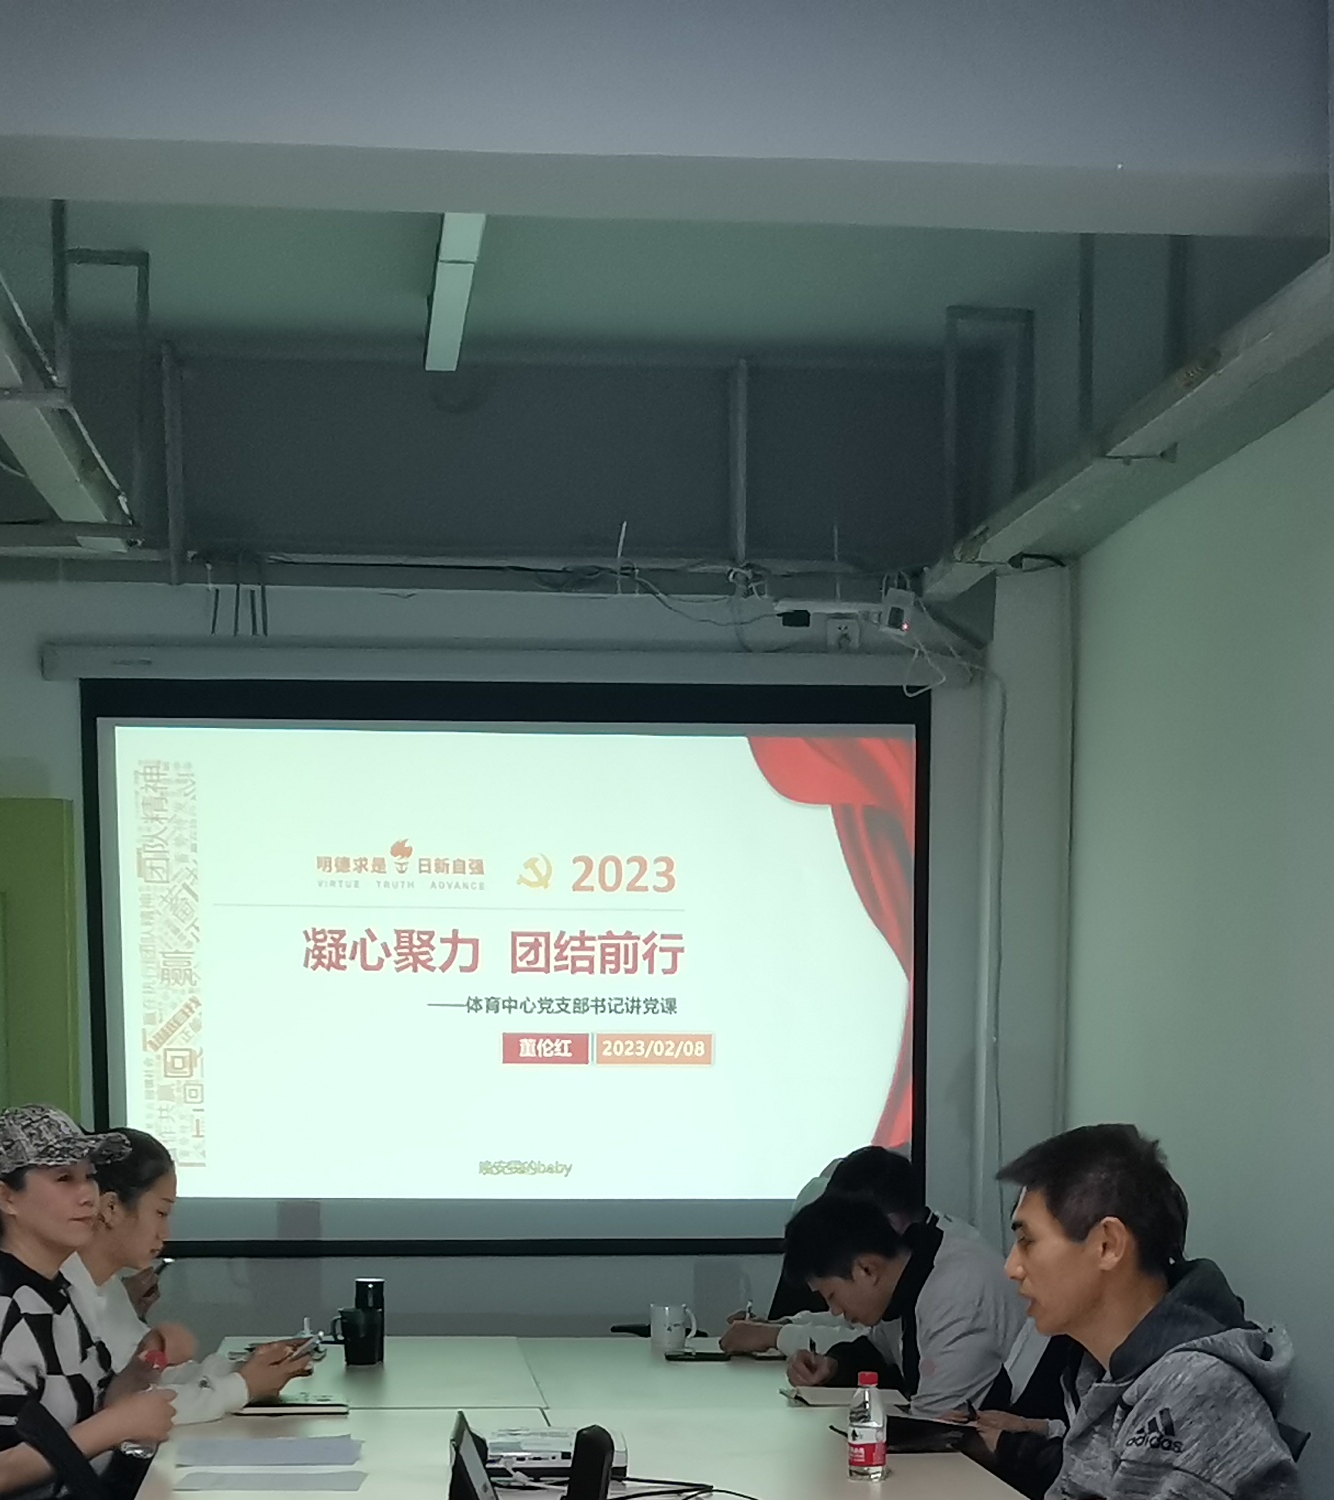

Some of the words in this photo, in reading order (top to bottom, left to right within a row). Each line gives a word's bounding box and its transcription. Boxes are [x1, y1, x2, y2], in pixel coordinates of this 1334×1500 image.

[317, 856, 387, 874] 明德求是
[418, 857, 485, 875] 日新自强
[571, 854, 676, 893] 2023
[317, 879, 360, 889] VIRTUE
[376, 880, 415, 889] TRUTH
[430, 881, 485, 891] ADVANCE
[303, 927, 480, 973] 凝心聚力
[511, 929, 685, 975] 团结前行
[601, 1039, 706, 1059] 2023/02/08
[1126, 1434, 1183, 1453] adidas
